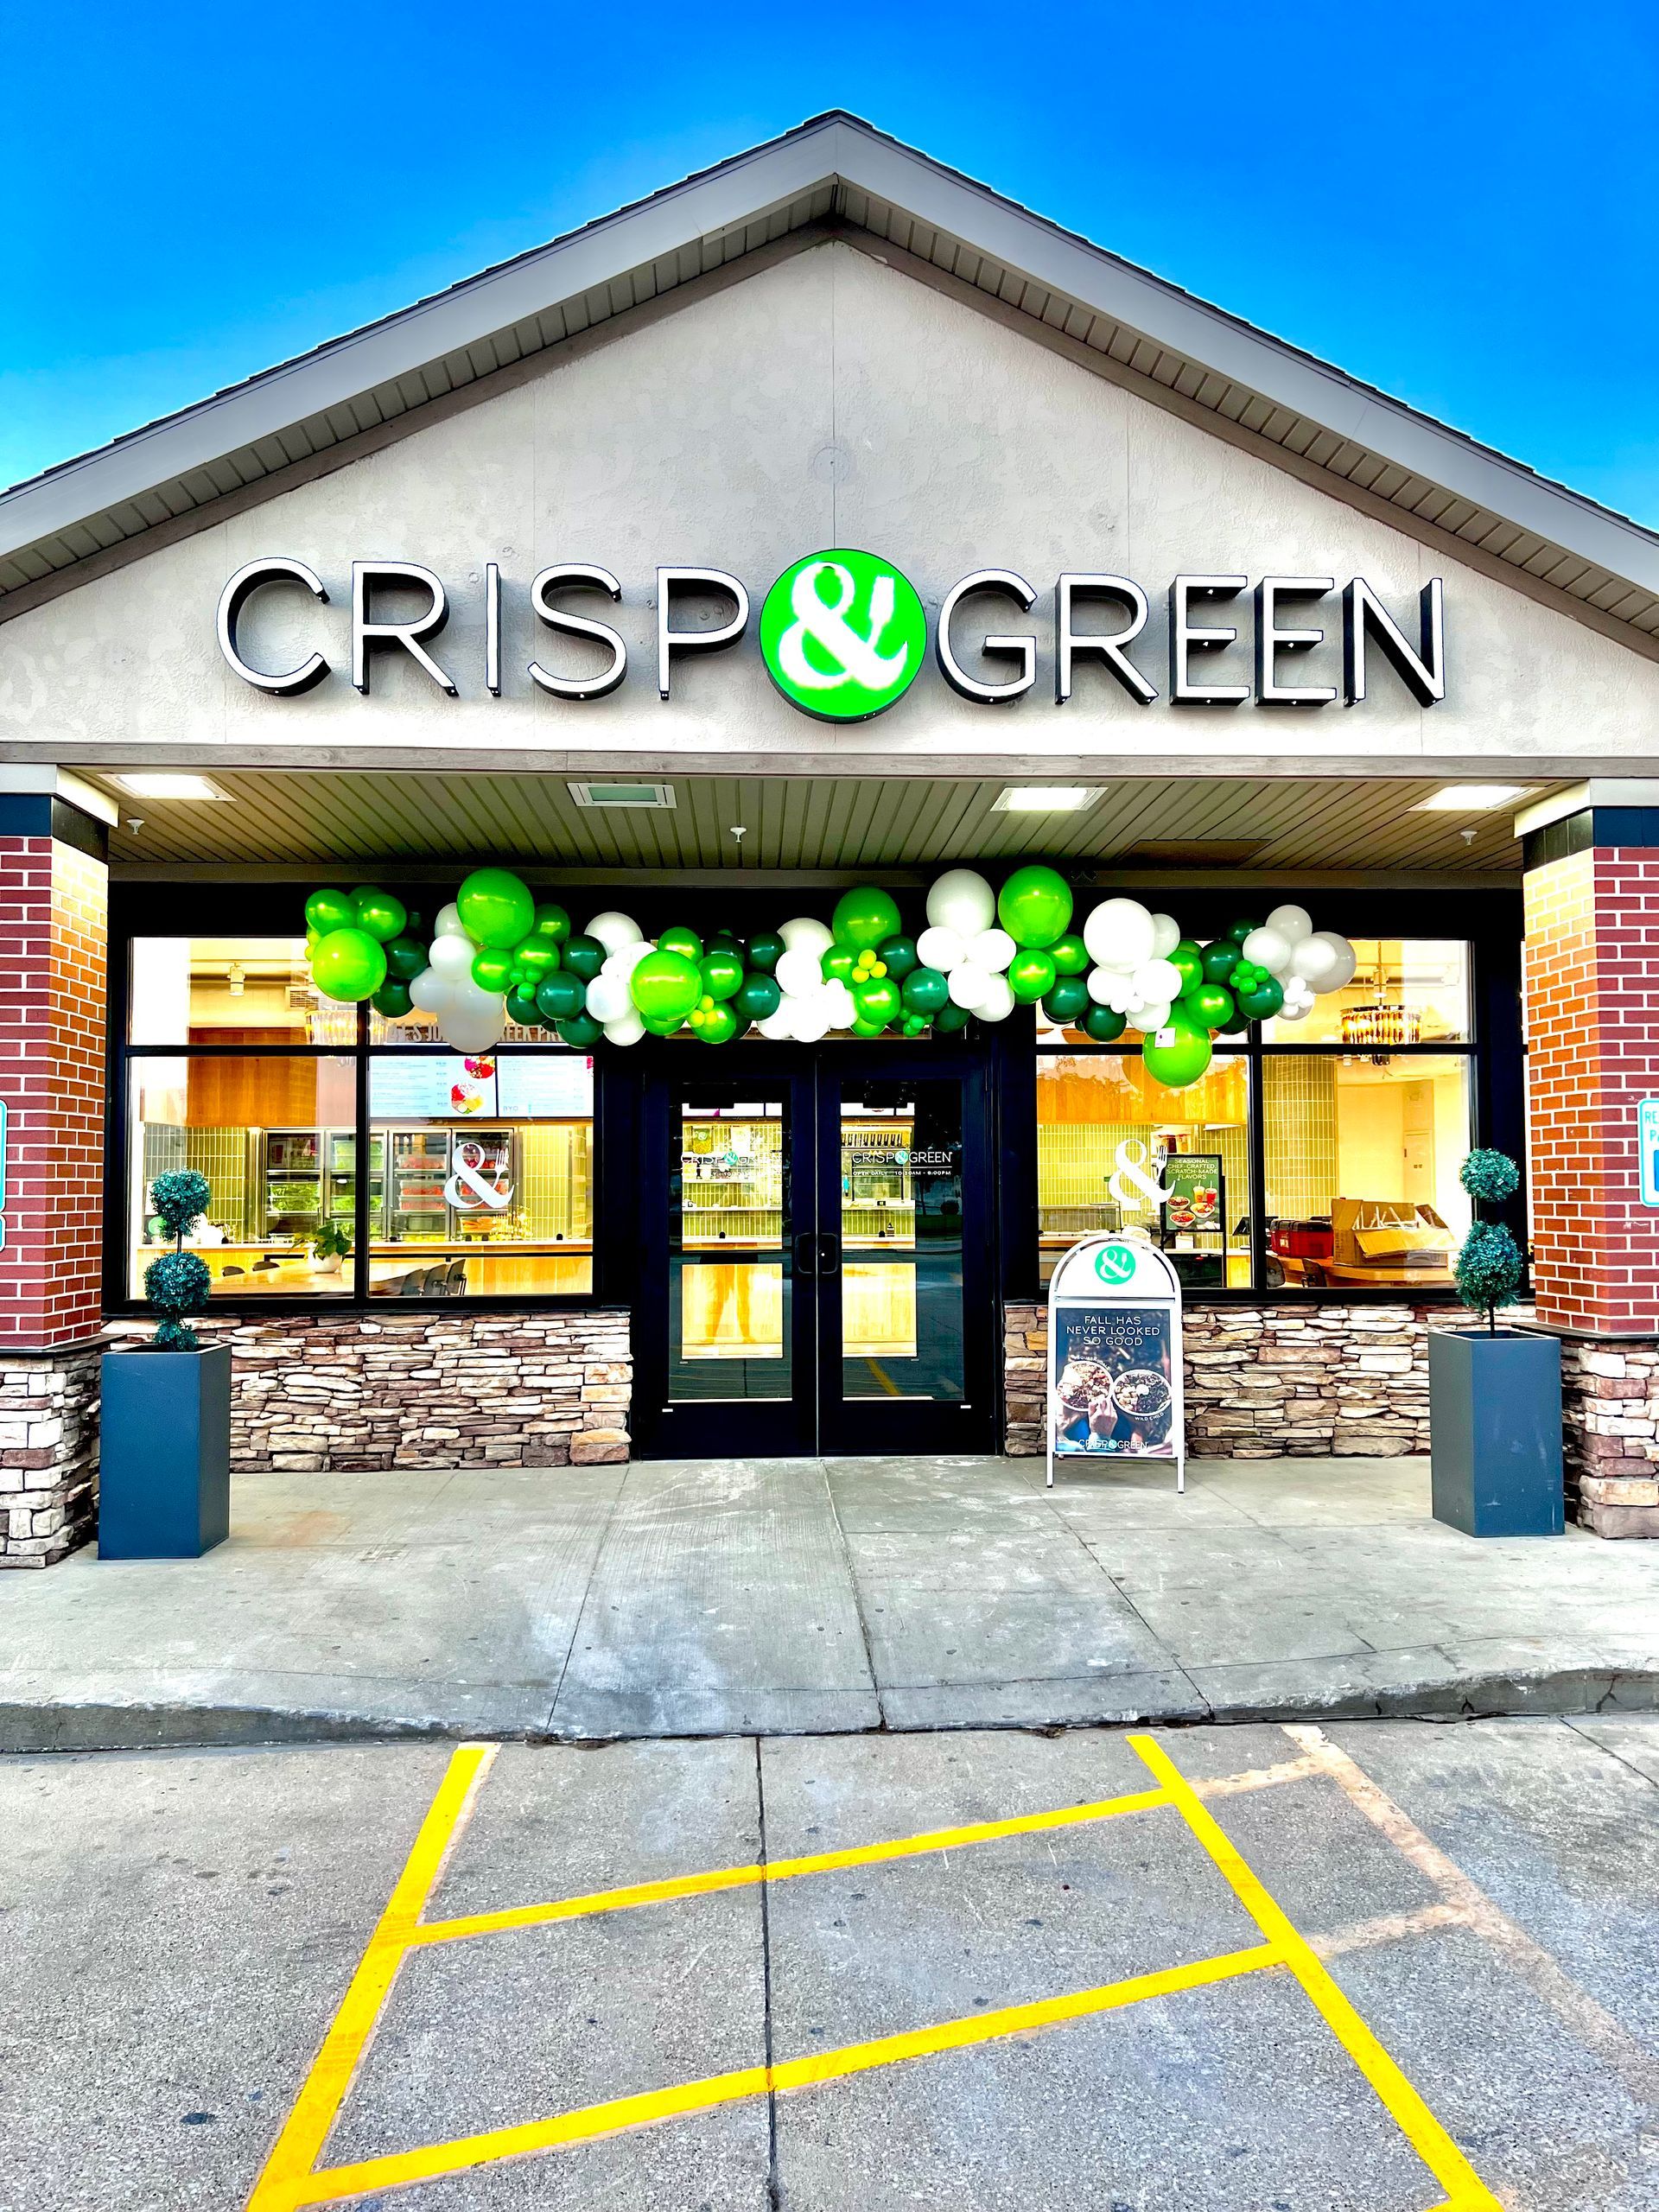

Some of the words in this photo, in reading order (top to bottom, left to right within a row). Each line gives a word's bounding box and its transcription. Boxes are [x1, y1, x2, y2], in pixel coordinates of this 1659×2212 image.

[216, 557, 749, 701] CRISP
[936, 569, 1446, 709] GREEN
[852, 1152, 895, 1164] CRISP
[909, 1151, 951, 1163] GREEN
[1084, 1316, 1111, 1325] FALL
[1116, 1316, 1141, 1325] HAS
[1066, 1325, 1106, 1335] NEVER
[1110, 1326, 1160, 1336] LOOKED
[1083, 1336, 1101, 1345] SO
[1105, 1337, 1143, 1346] GOOD
[1149, 1412, 1165, 1421] CHILD
[1117, 1440, 1147, 1450] GREEN
